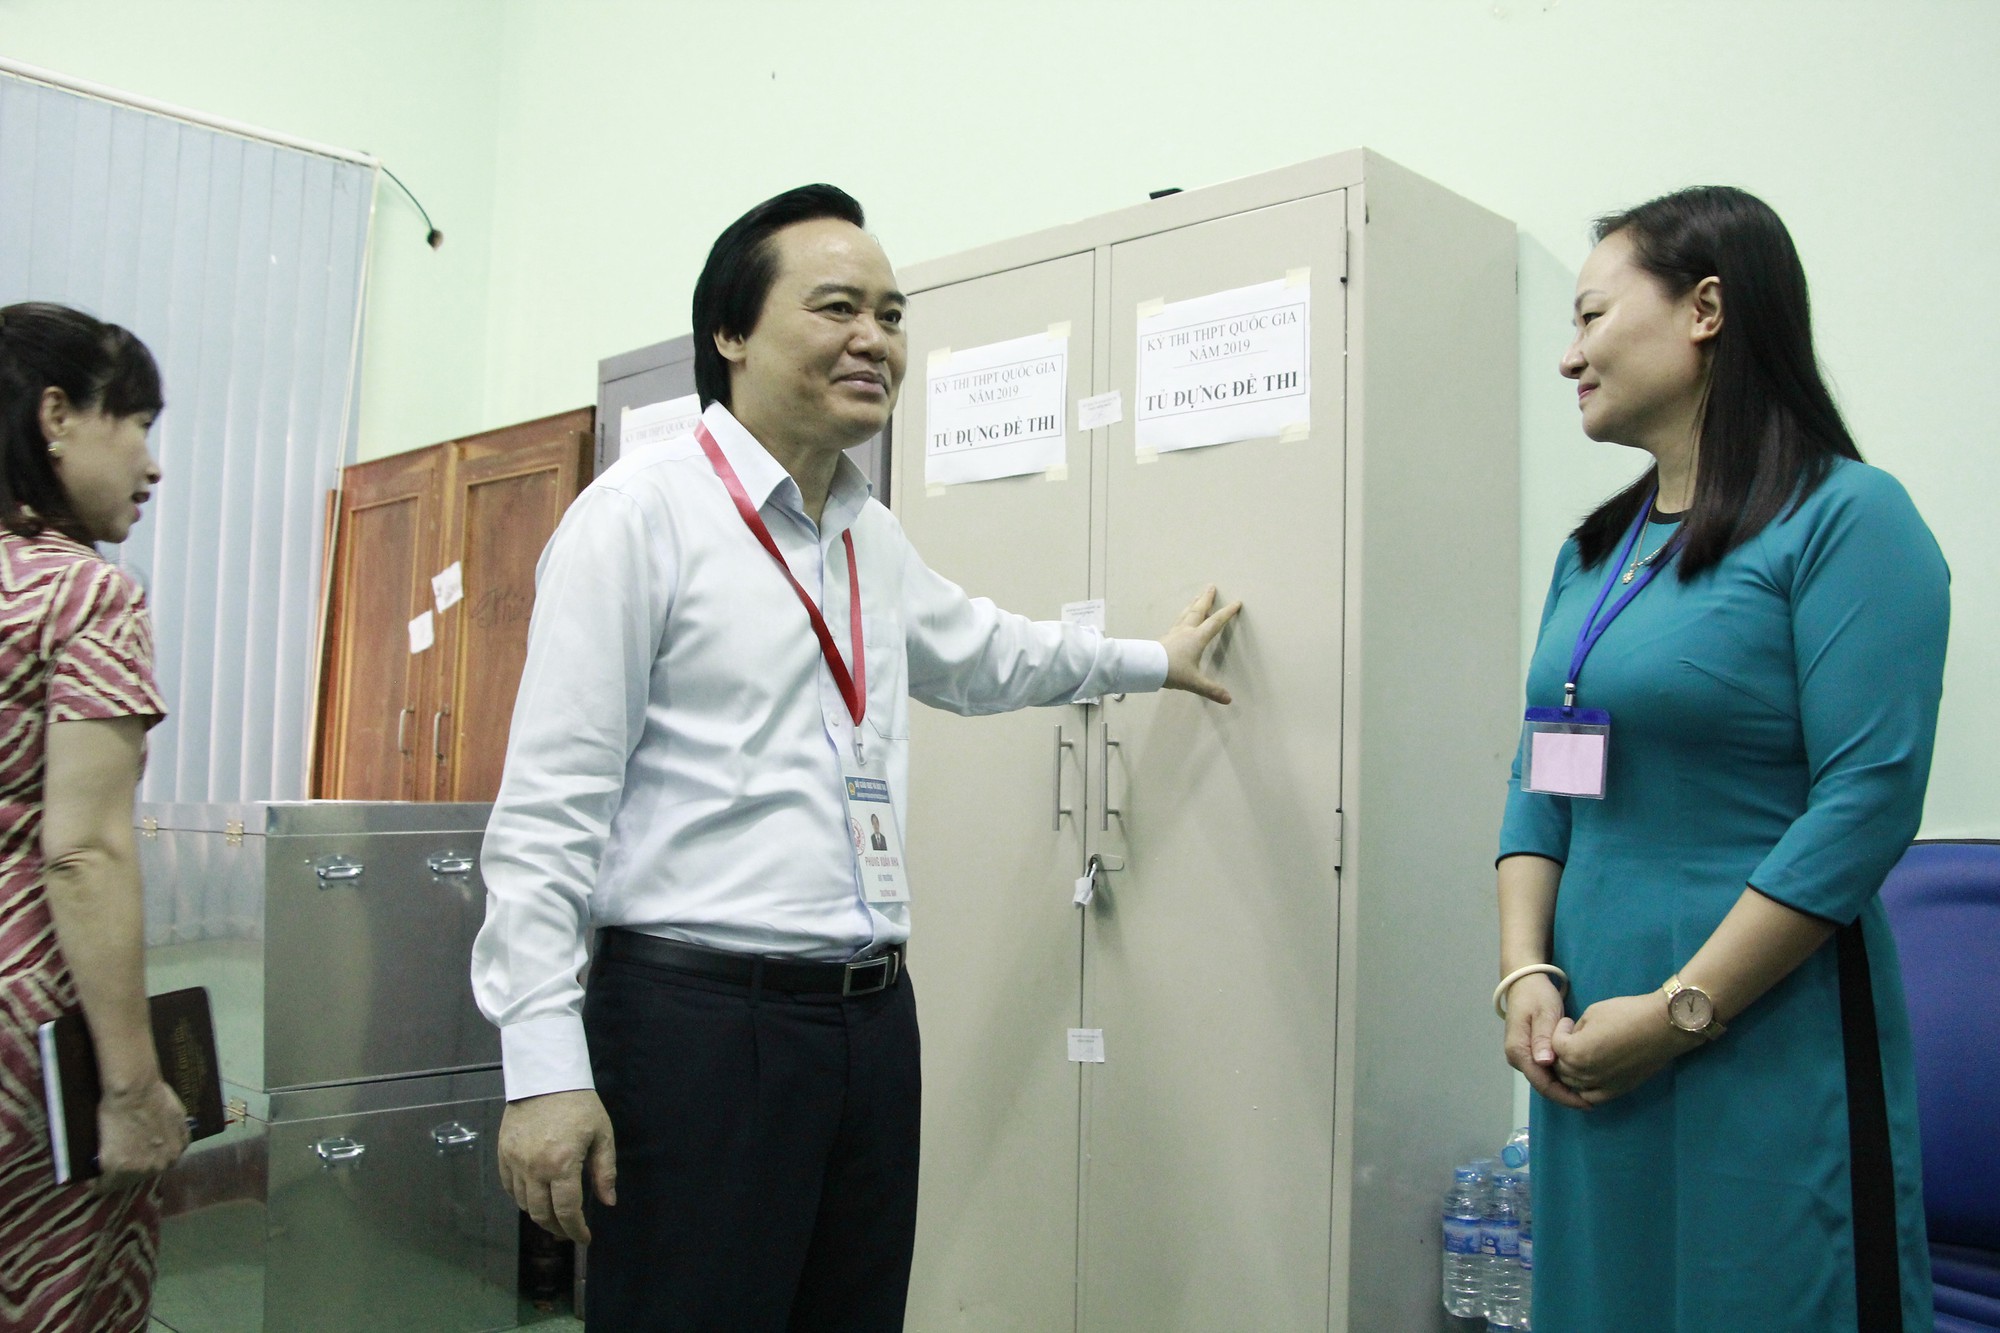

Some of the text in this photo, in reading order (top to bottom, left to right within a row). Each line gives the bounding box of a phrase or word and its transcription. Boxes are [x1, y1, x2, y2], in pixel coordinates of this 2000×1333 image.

[1169, 332, 1190, 347] THI
[1193, 323, 1226, 342] THPT
[1271, 311, 1297, 327] GIA
[1223, 338, 1250, 356] 2019
[952, 377, 970, 390] THI
[972, 371, 999, 387] THPT
[1035, 361, 1056, 375] GIA
[1173, 383, 1227, 409] ĐỰNG
[1262, 371, 1298, 392] THI
[997, 384, 1019, 400] 2019
[956, 424, 999, 447] ĐỰNG
[1027, 415, 1055, 432] THI
